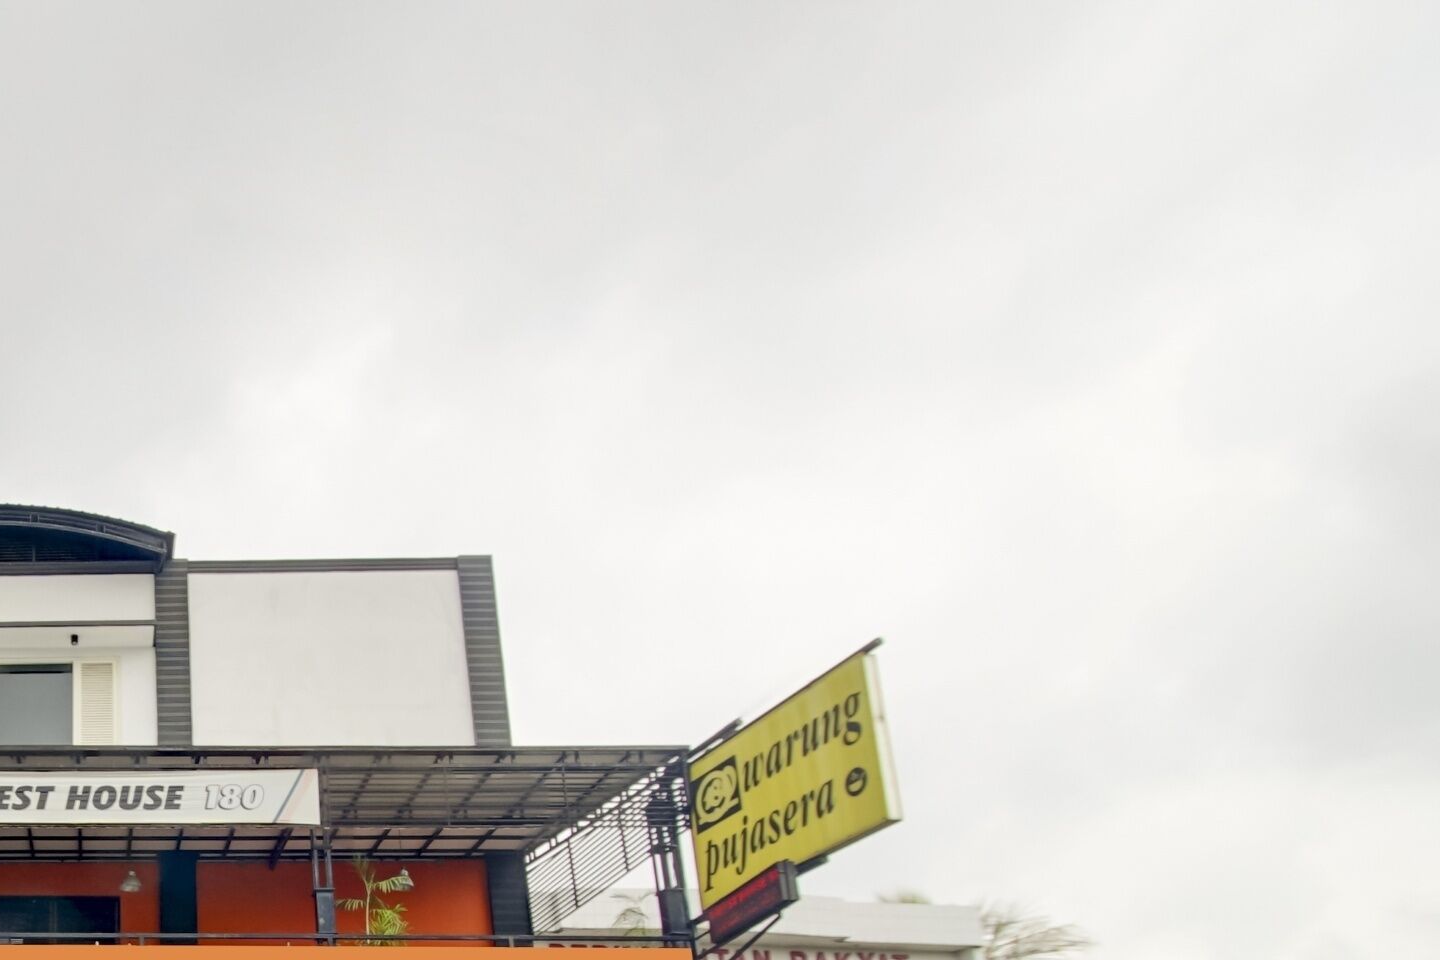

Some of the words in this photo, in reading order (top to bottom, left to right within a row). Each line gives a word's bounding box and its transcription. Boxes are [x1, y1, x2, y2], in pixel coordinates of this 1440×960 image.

[742, 690, 863, 794] warung
[65, 785, 184, 811] HOUSE
[204, 784, 265, 811] 180
[703, 778, 835, 893] pujasera
